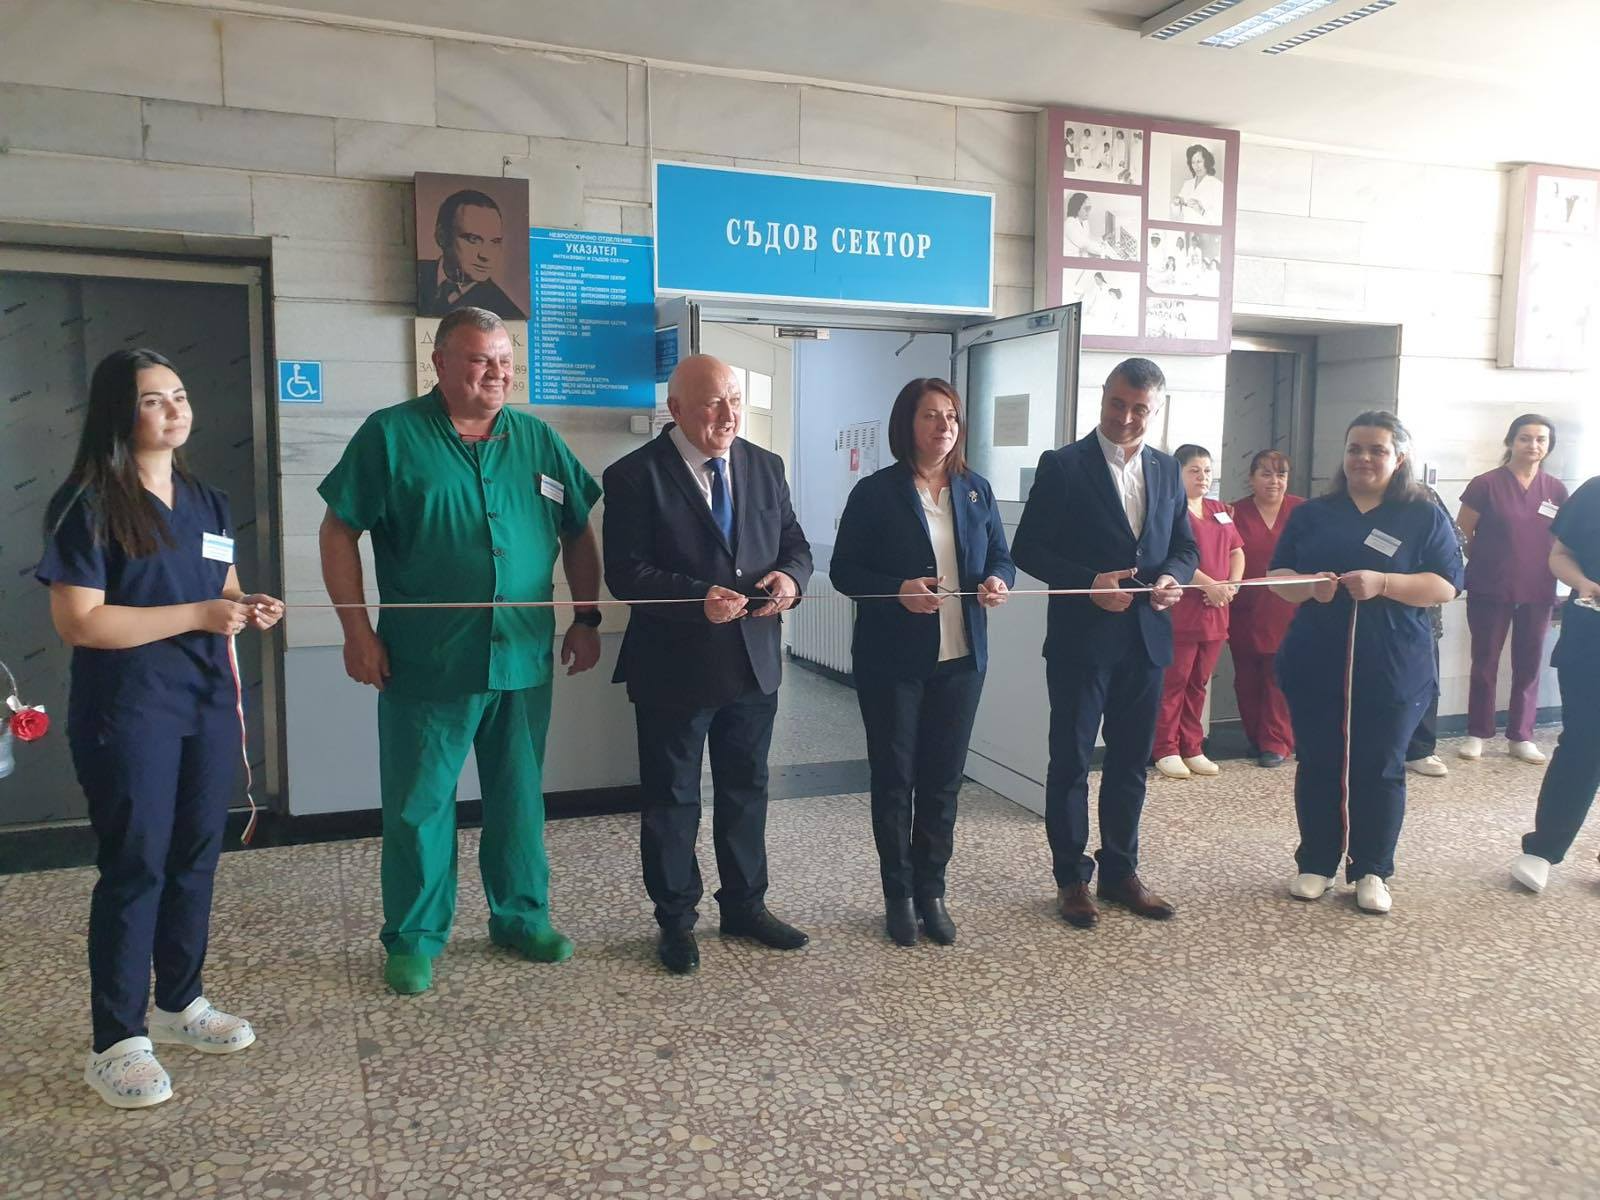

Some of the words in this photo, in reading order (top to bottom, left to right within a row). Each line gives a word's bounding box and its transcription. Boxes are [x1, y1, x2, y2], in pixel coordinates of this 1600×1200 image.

[549, 231, 597, 241] НЕВРОЛОГИЧНО
[598, 235, 632, 243] ОТДЕЛЕНИЕ
[726, 218, 818, 255] СЪДОВ
[832, 227, 931, 258] СЕКТОР
[565, 243, 617, 256] УКАЗАТЕЛ
[513, 363, 527, 375] 89
[512, 380, 525, 392] 89
